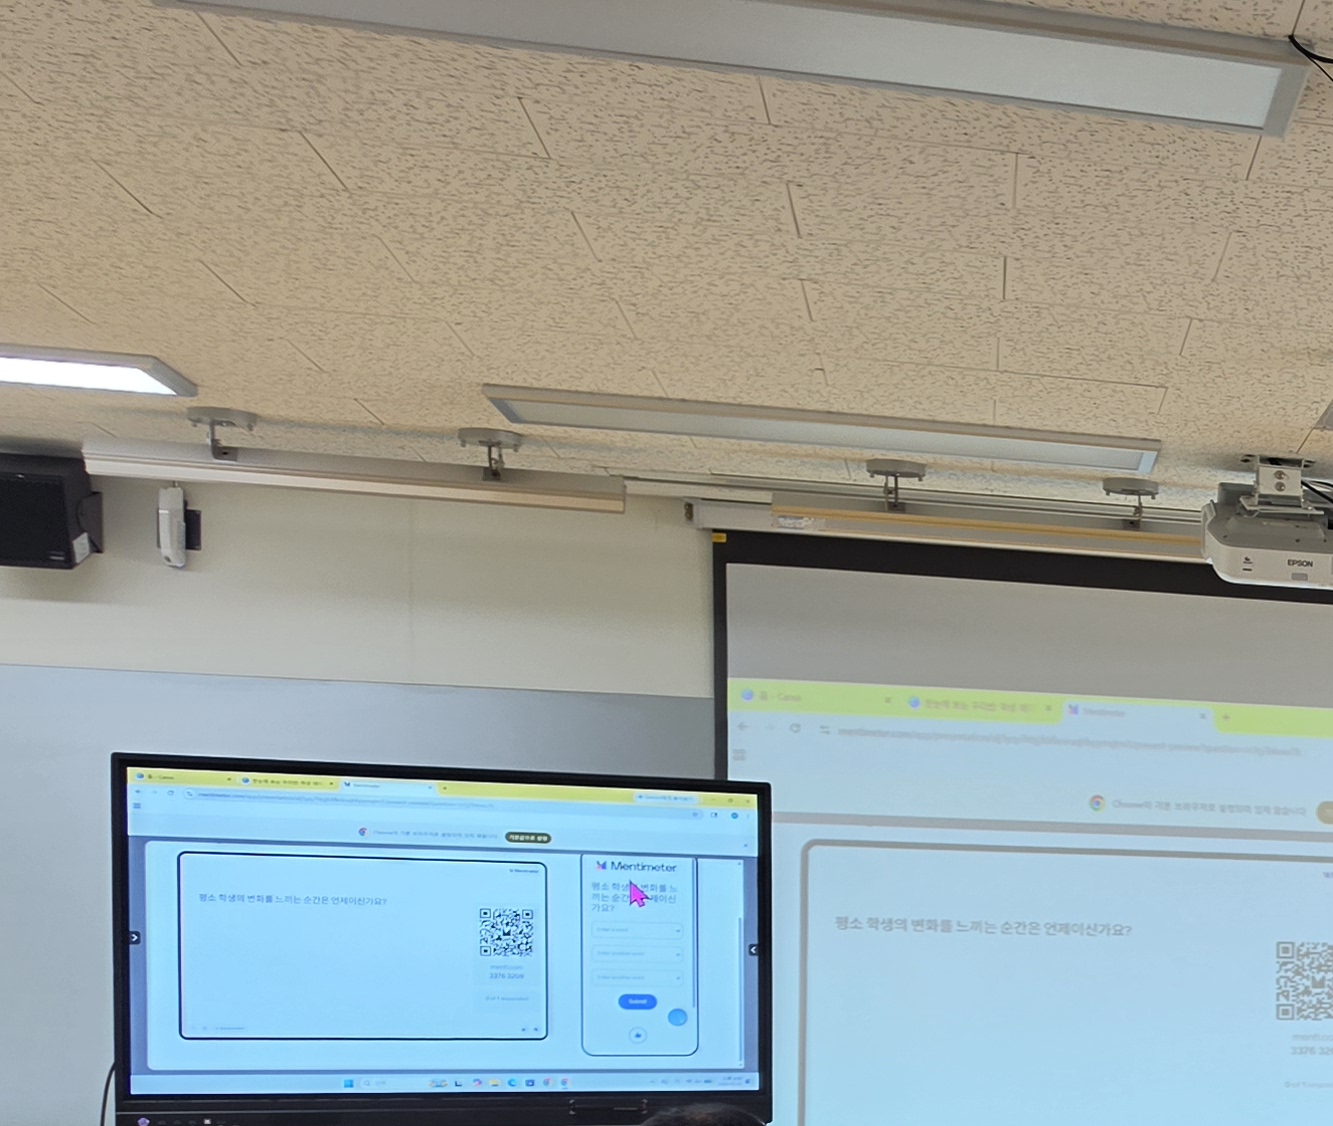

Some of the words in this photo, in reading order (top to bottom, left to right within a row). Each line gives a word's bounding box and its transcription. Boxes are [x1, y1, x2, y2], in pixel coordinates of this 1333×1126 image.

[1288, 559, 1313, 567] EPSON
[611, 861, 677, 872] Mentimeter
[834, 916, 864, 930] 평소
[866, 917, 908, 931] 학생의
[911, 918, 953, 933] 변화를
[955, 920, 997, 934] 느끼는
[1000, 921, 1041, 936] 순간은
[1043, 922, 1133, 937] 언제이신가요?
